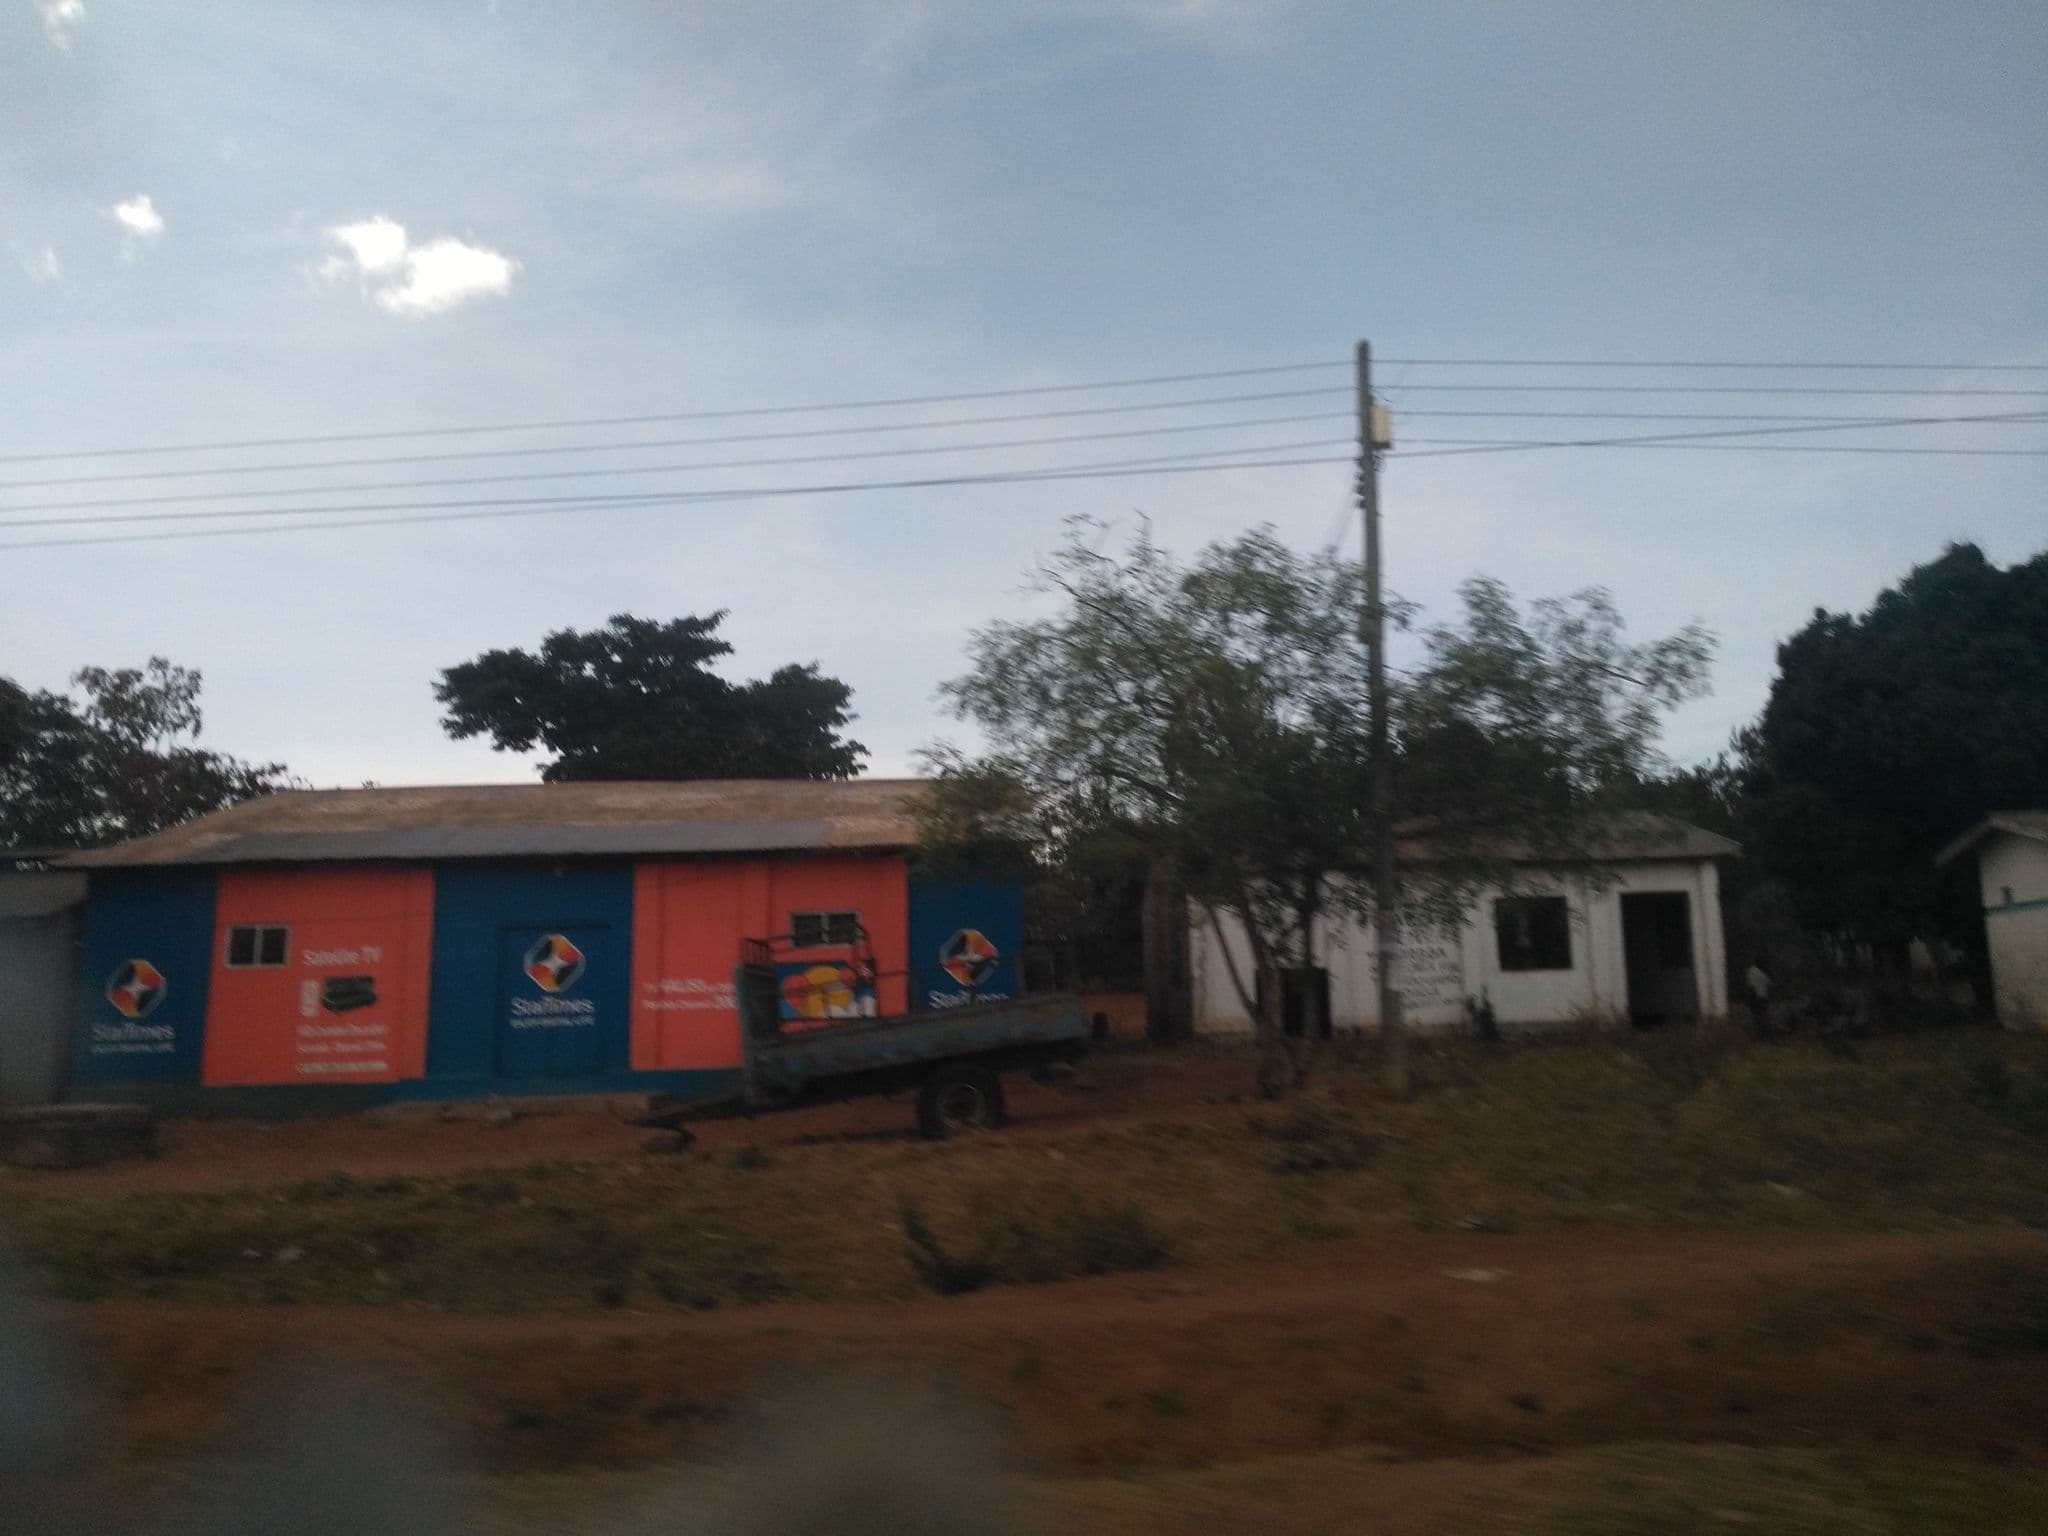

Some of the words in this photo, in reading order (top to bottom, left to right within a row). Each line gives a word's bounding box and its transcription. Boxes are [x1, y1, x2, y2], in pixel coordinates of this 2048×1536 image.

[361, 946, 383, 964] TV
[511, 996, 595, 1015] StarTimes
[93, 1022, 176, 1042] StarTimes
